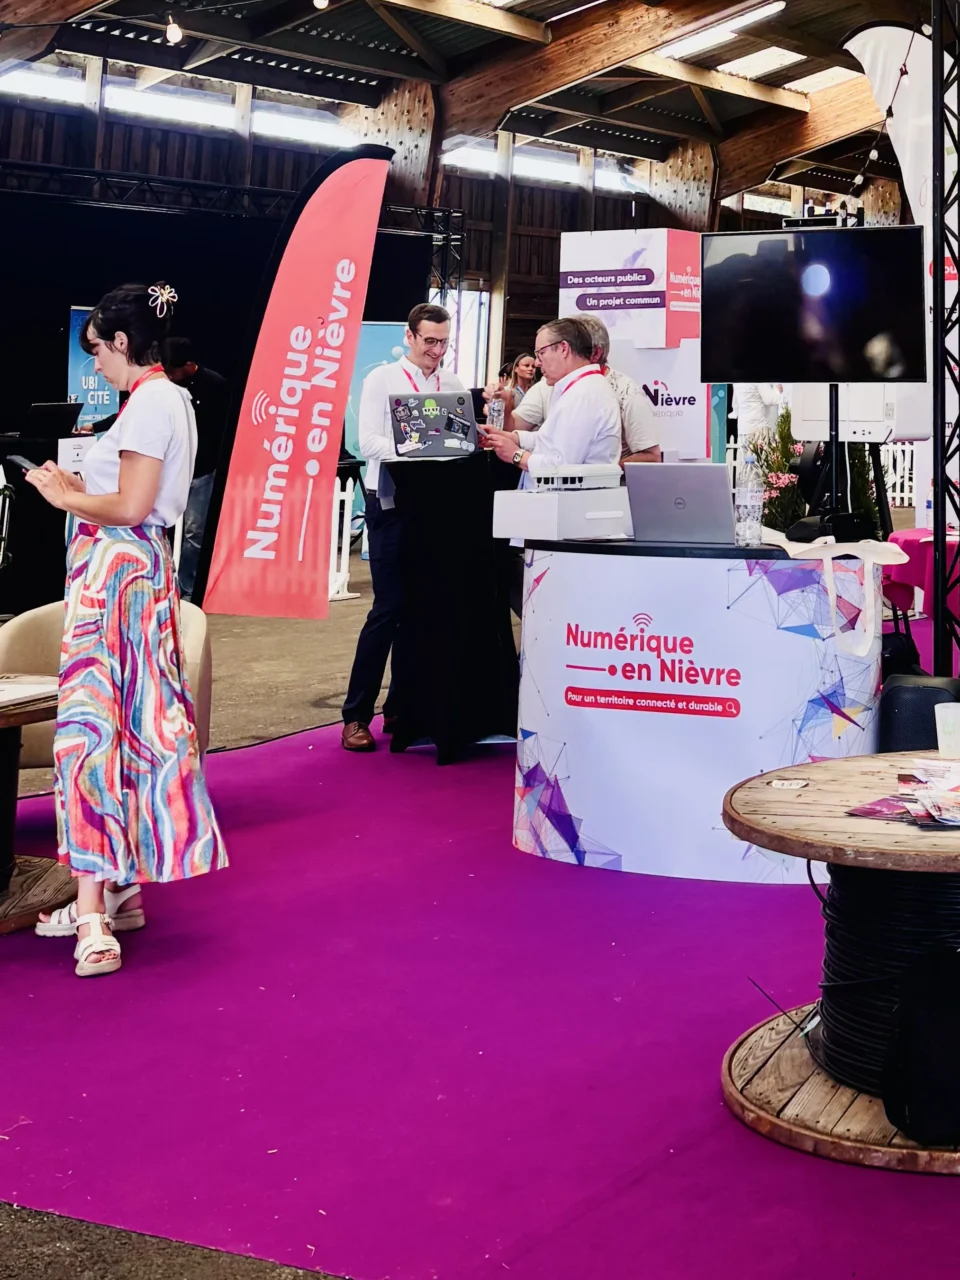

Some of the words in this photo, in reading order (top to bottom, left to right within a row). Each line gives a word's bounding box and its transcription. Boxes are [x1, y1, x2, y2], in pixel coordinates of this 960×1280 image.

[567, 275, 583, 284] Des
[585, 275, 616, 284] acteurs
[616, 273, 647, 284] publics
[586, 298, 598, 307] Un
[599, 296, 624, 308] projet
[625, 296, 661, 306] commun
[311, 257, 356, 388] Nièvre
[81, 375, 98, 390] UBI
[87, 385, 111, 405] CITÉ
[306, 402, 334, 453] en
[243, 325, 314, 560] Numérique
[565, 622, 694, 659] Numérique
[621, 662, 651, 682] en
[659, 658, 742, 687] Nièvre
[567, 691, 583, 702] Pour
[584, 696, 595, 704] un
[597, 695, 634, 706] territoire
[636, 698, 676, 709] connecté
[678, 701, 687, 710] et
[688, 701, 723, 712] durable
